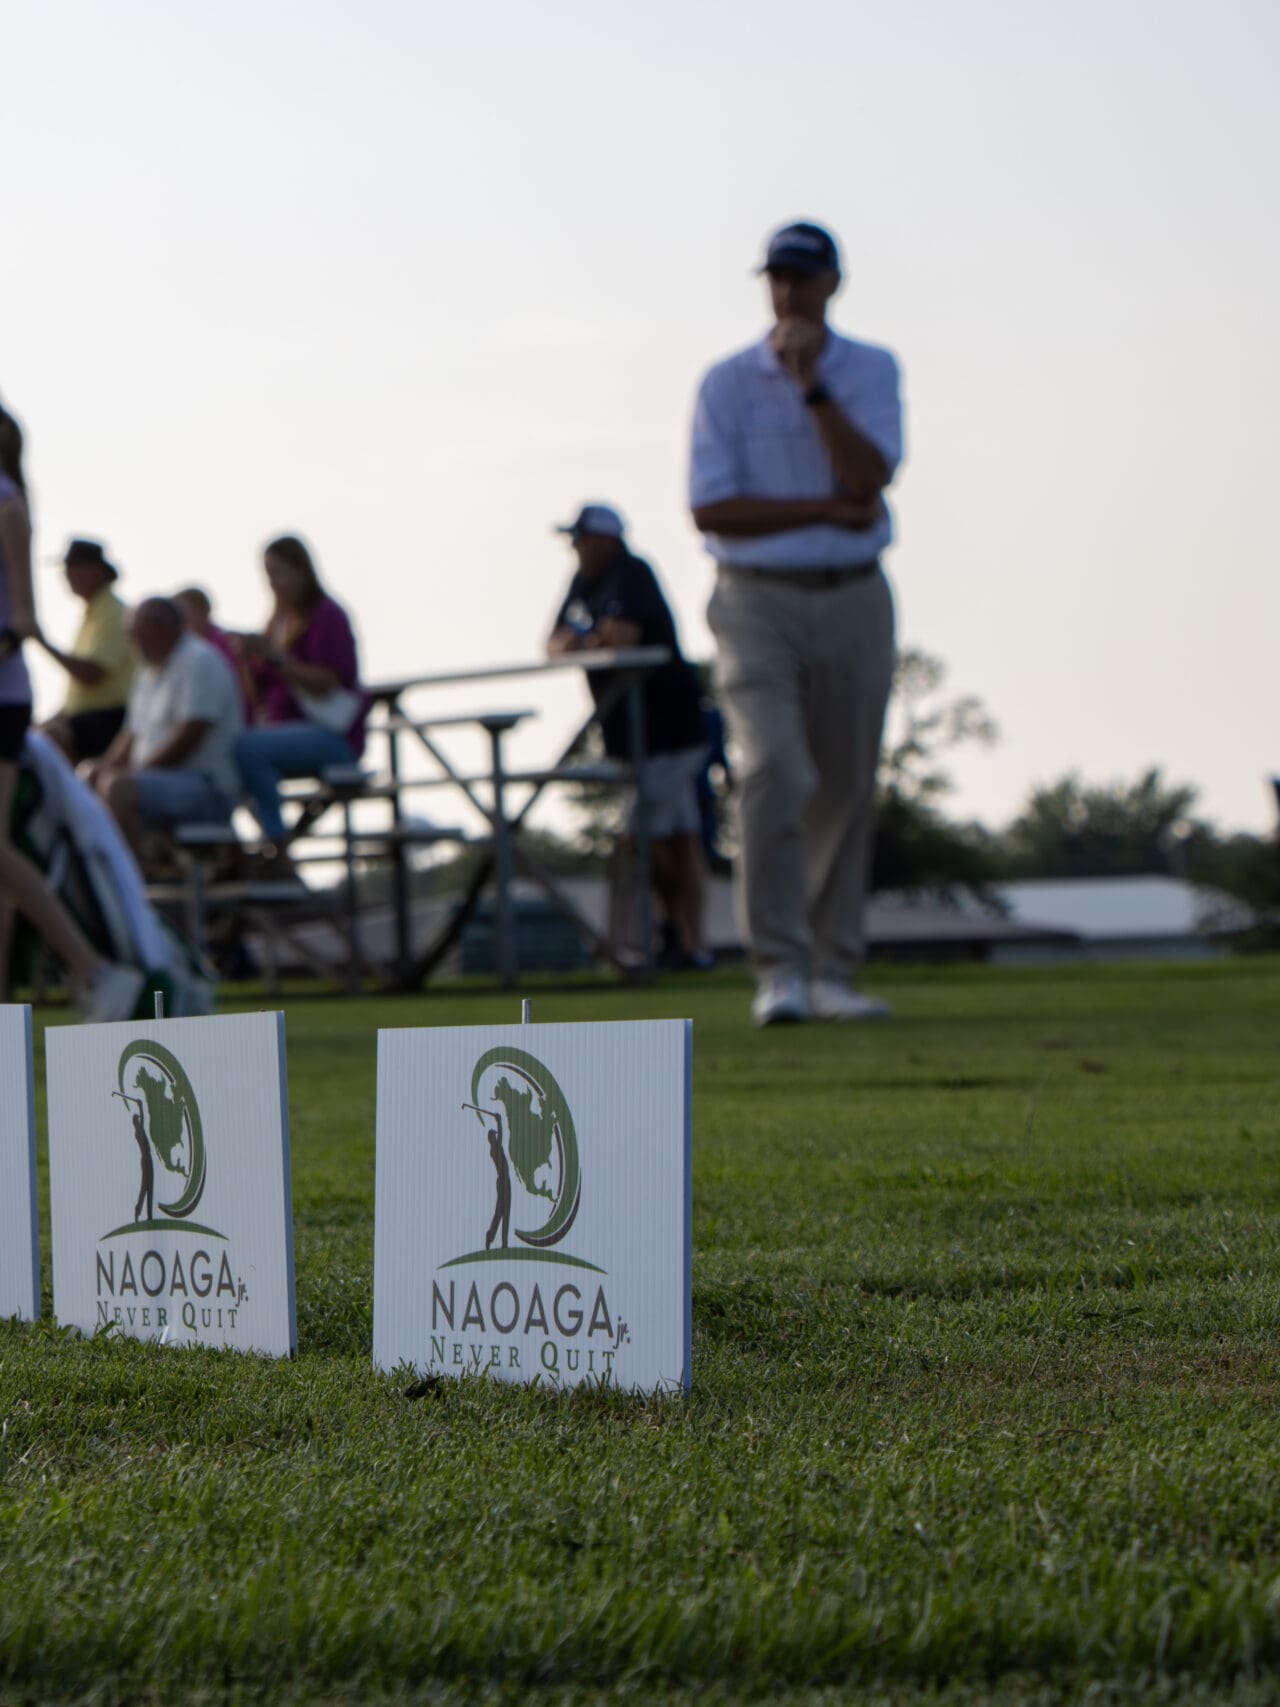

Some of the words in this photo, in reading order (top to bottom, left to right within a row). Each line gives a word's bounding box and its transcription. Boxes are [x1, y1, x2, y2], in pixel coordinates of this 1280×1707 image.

[96, 1249, 236, 1298] NAOAGA
[96, 1301, 169, 1328] NEVER
[182, 1301, 238, 1333] QUIT
[431, 1280, 614, 1338] NAOAGA
[430, 1335, 520, 1368] NEVER
[540, 1340, 615, 1376] QUIT
